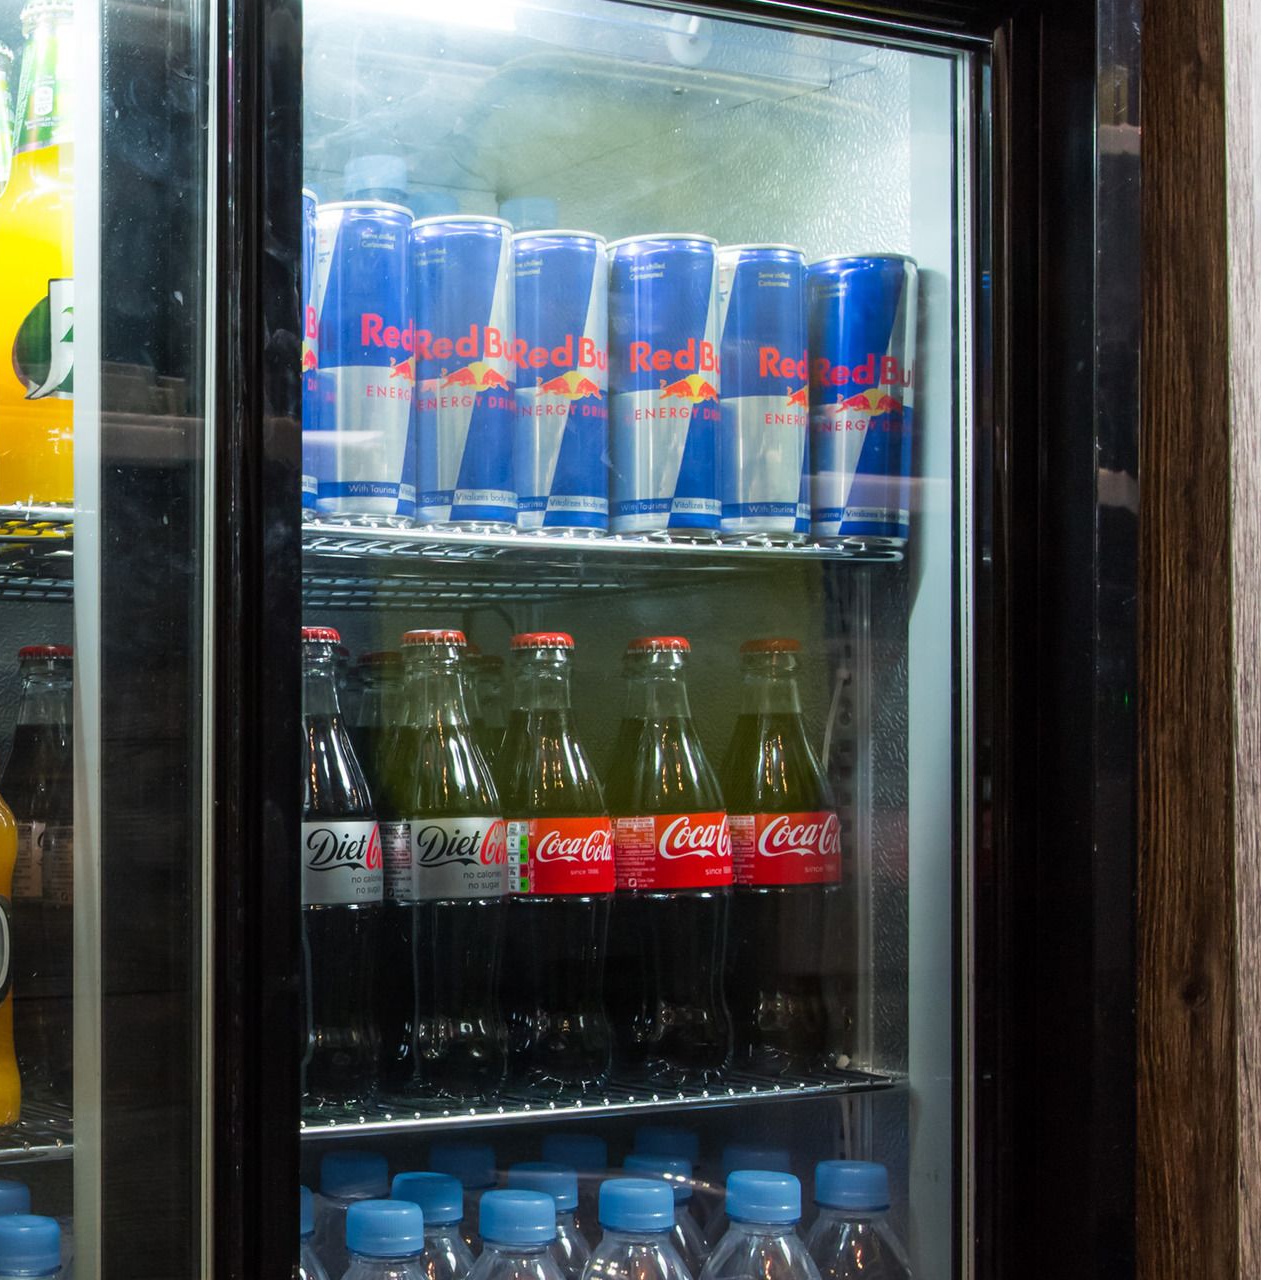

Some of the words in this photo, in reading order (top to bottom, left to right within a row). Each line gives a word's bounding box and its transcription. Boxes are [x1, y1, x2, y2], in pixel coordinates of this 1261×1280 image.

[415, 324, 478, 361] Red
[484, 327, 516, 362] Bu
[515, 334, 573, 369] Red
[578, 336, 608, 371] Bu
[629, 338, 695, 373] Red
[813, 353, 875, 387] Red
[366, 385, 410, 401] ENERG
[522, 404, 577, 417] NERGY
[635, 407, 698, 420] ENERGY
[764, 413, 806, 426] ENERG
[821, 420, 877, 433] NERGY
[348, 484, 368, 494] With
[519, 501, 545, 511] aurine.
[306, 828, 367, 867] Diet
[417, 825, 481, 864] Diet
[535, 830, 613, 863] Coca-Cola
[705, 868, 722, 876] since
[468, 882, 480, 890] no
